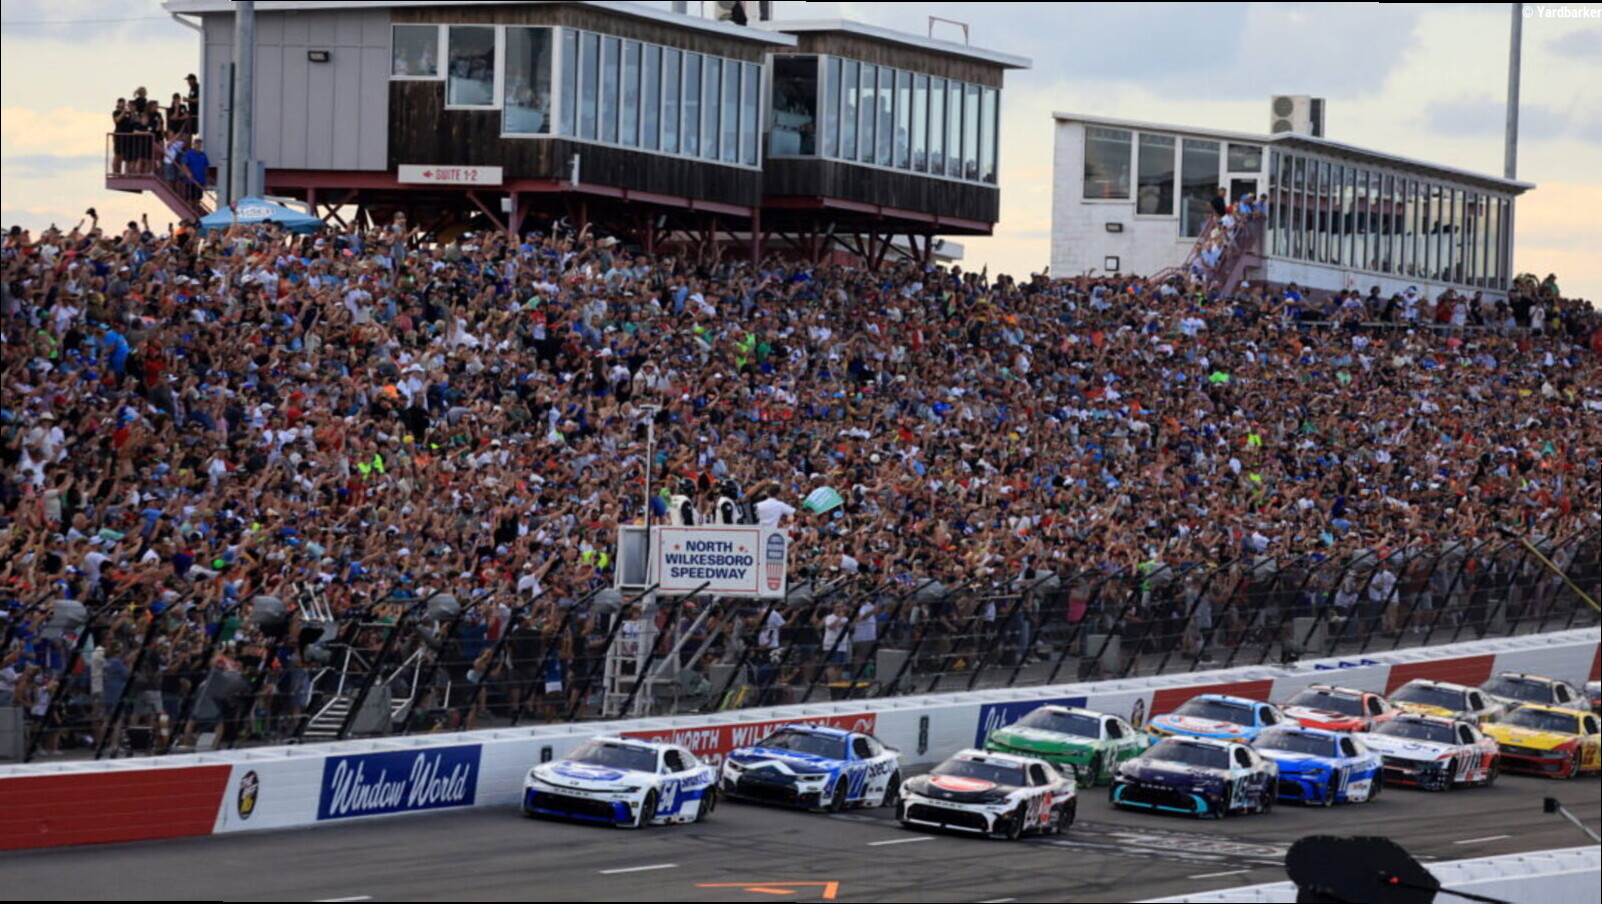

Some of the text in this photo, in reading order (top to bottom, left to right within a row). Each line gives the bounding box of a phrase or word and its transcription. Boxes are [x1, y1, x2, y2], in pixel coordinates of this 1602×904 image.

[435, 168, 461, 181] SUITE
[686, 541, 733, 552] NORTH
[665, 554, 754, 566] WILKESBORO
[670, 567, 747, 579] SPEEDWAY
[675, 729, 719, 750] NORTH
[329, 752, 470, 816] Window World
[658, 781, 679, 812] 54
